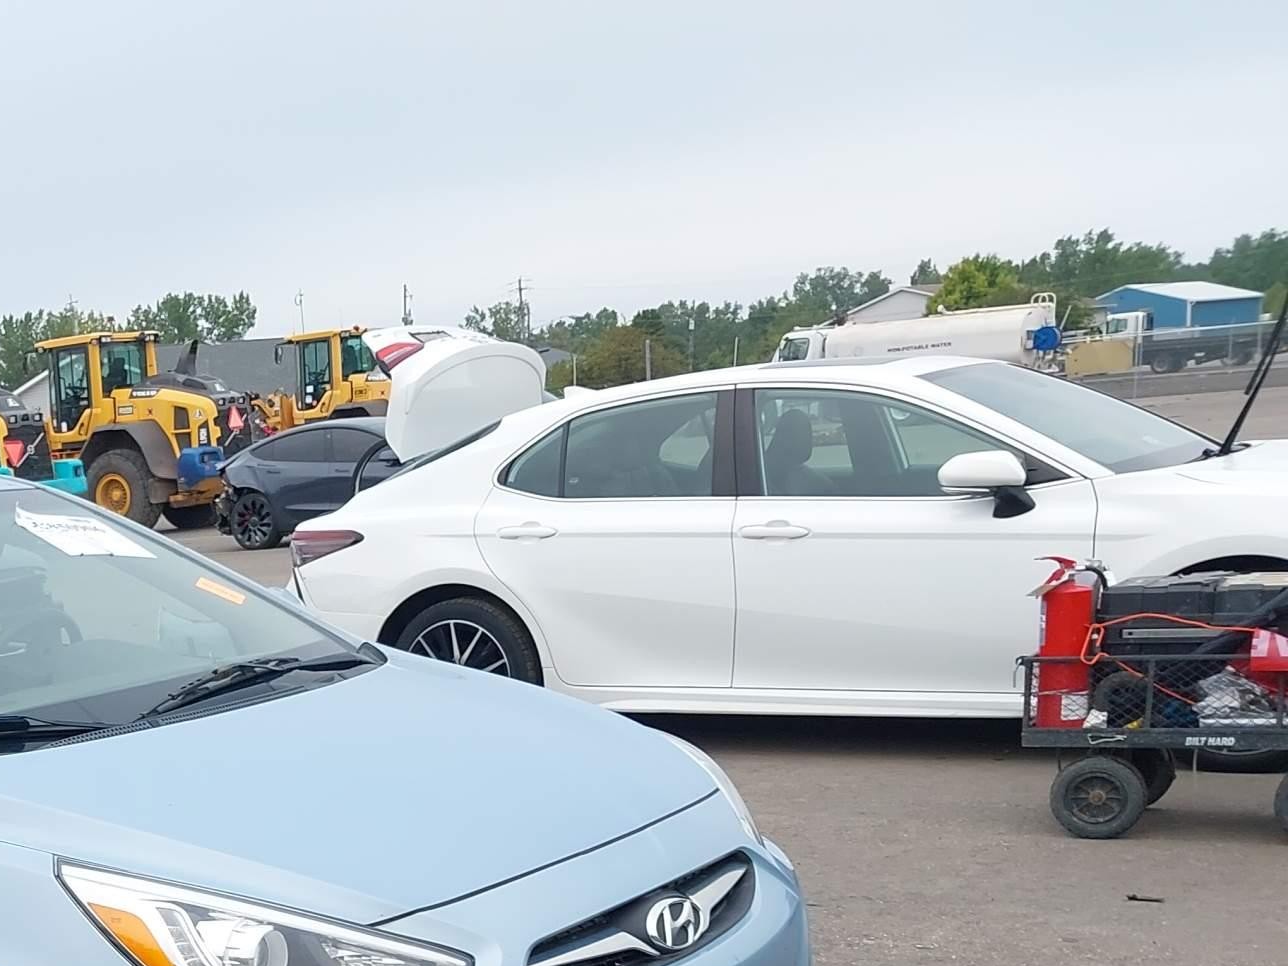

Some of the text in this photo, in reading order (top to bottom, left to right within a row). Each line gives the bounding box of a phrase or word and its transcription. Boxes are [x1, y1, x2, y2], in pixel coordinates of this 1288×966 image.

[930, 341, 952, 349] WATER
[1185, 736, 1236, 747] BILT HARD
